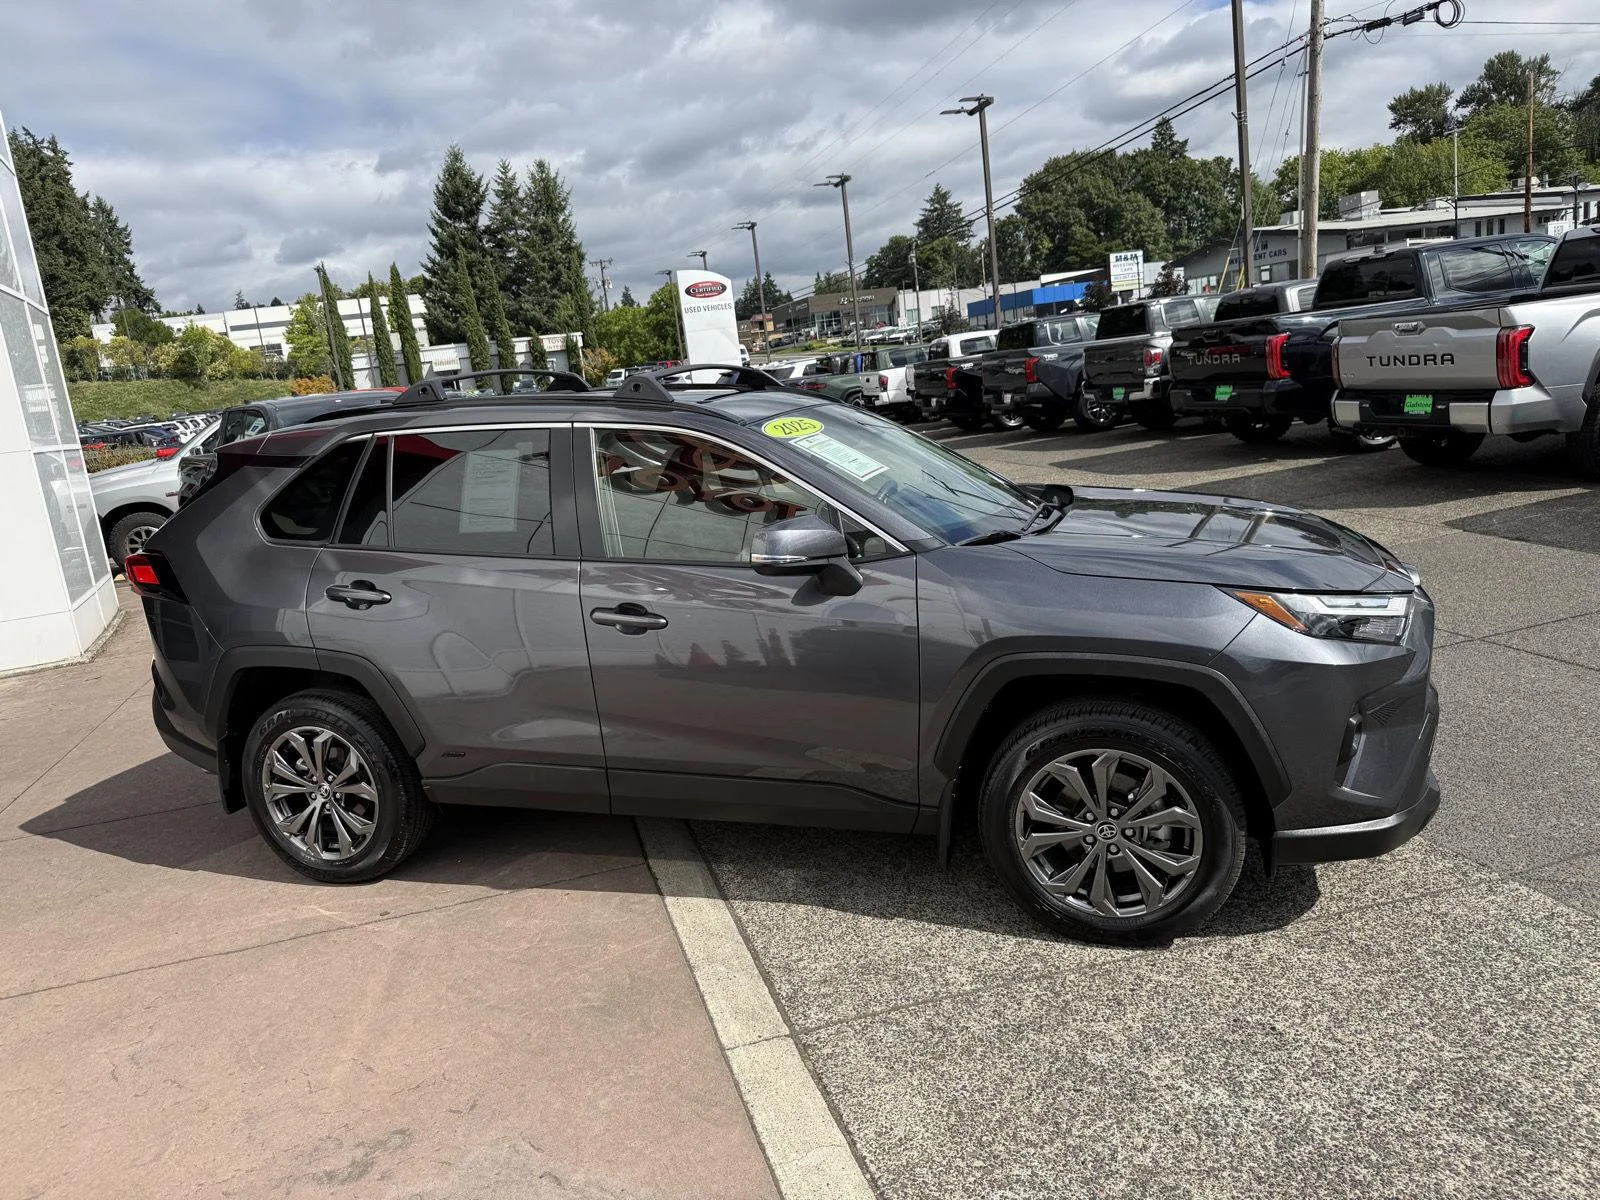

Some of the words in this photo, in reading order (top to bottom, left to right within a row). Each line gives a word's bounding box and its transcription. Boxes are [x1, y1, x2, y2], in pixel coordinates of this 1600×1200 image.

[1269, 248, 1288, 258] CARS
[690, 285, 722, 294] CERTIFIED
[684, 305, 702, 314] USED
[703, 302, 733, 312] VEHICLES
[1187, 353, 1241, 366] TUNDRA
[1366, 352, 1455, 367] TUNDRA
[773, 419, 817, 436] 2025
